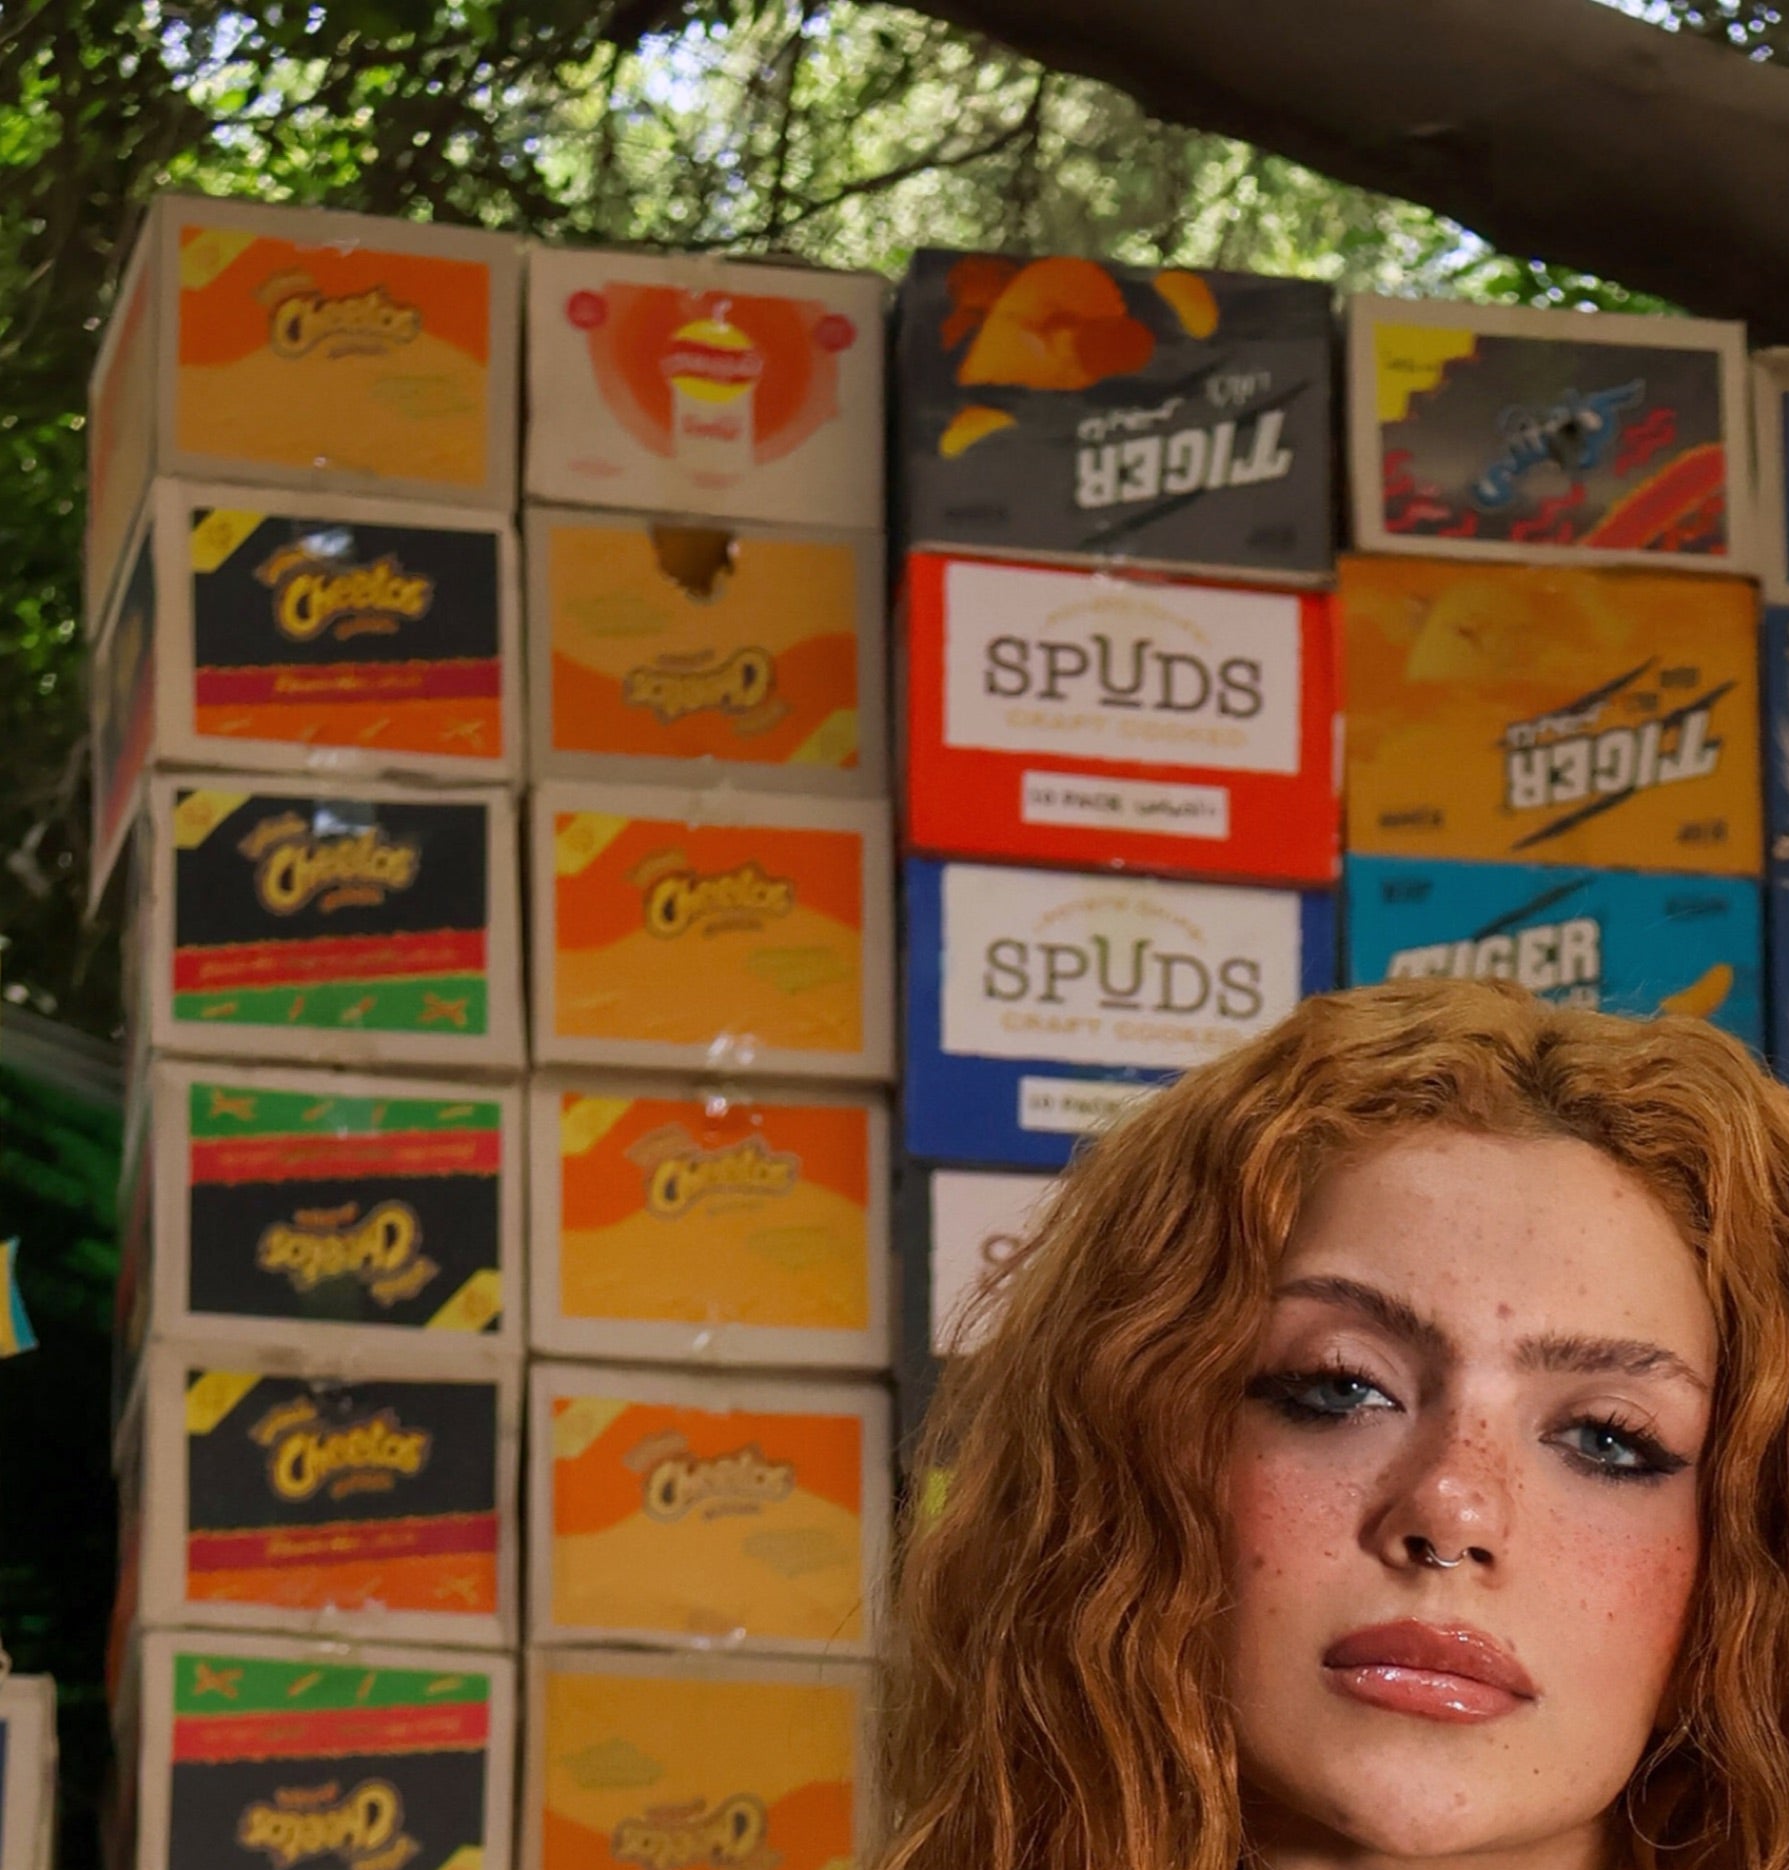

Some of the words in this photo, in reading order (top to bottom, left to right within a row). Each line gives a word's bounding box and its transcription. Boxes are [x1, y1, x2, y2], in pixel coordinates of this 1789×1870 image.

[1075, 409, 1291, 509] TIGER
[983, 632, 1263, 719] SPUDS
[1508, 710, 1718, 809] TIGER
[983, 935, 1263, 1019] SPUDS
[270, 1412, 429, 1500] Cheetos
